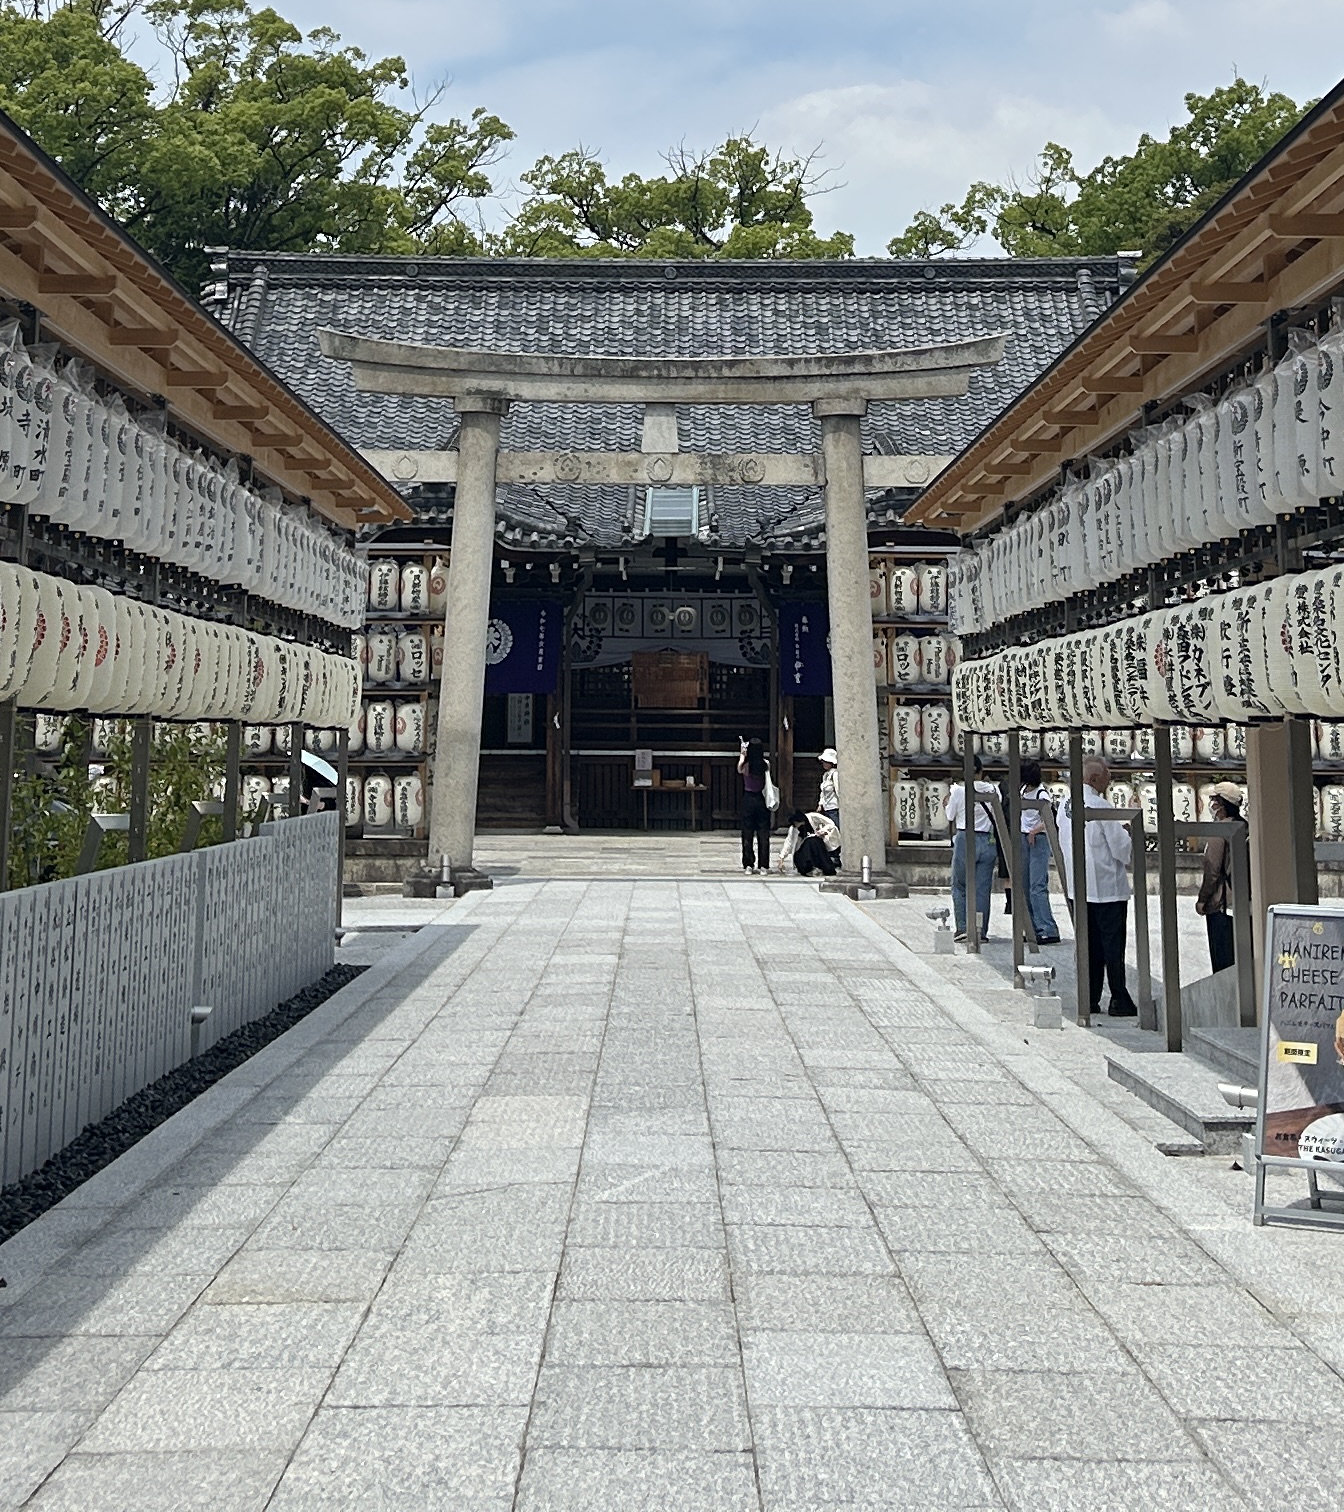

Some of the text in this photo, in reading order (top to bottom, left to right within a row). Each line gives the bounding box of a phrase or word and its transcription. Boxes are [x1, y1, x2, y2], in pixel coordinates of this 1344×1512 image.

[29, 417, 51, 492] 清水町
[1295, 600, 1315, 656] 株式会社
[1281, 968, 1339, 986] CHEESE
[1298, 1144, 1313, 1154] THE
